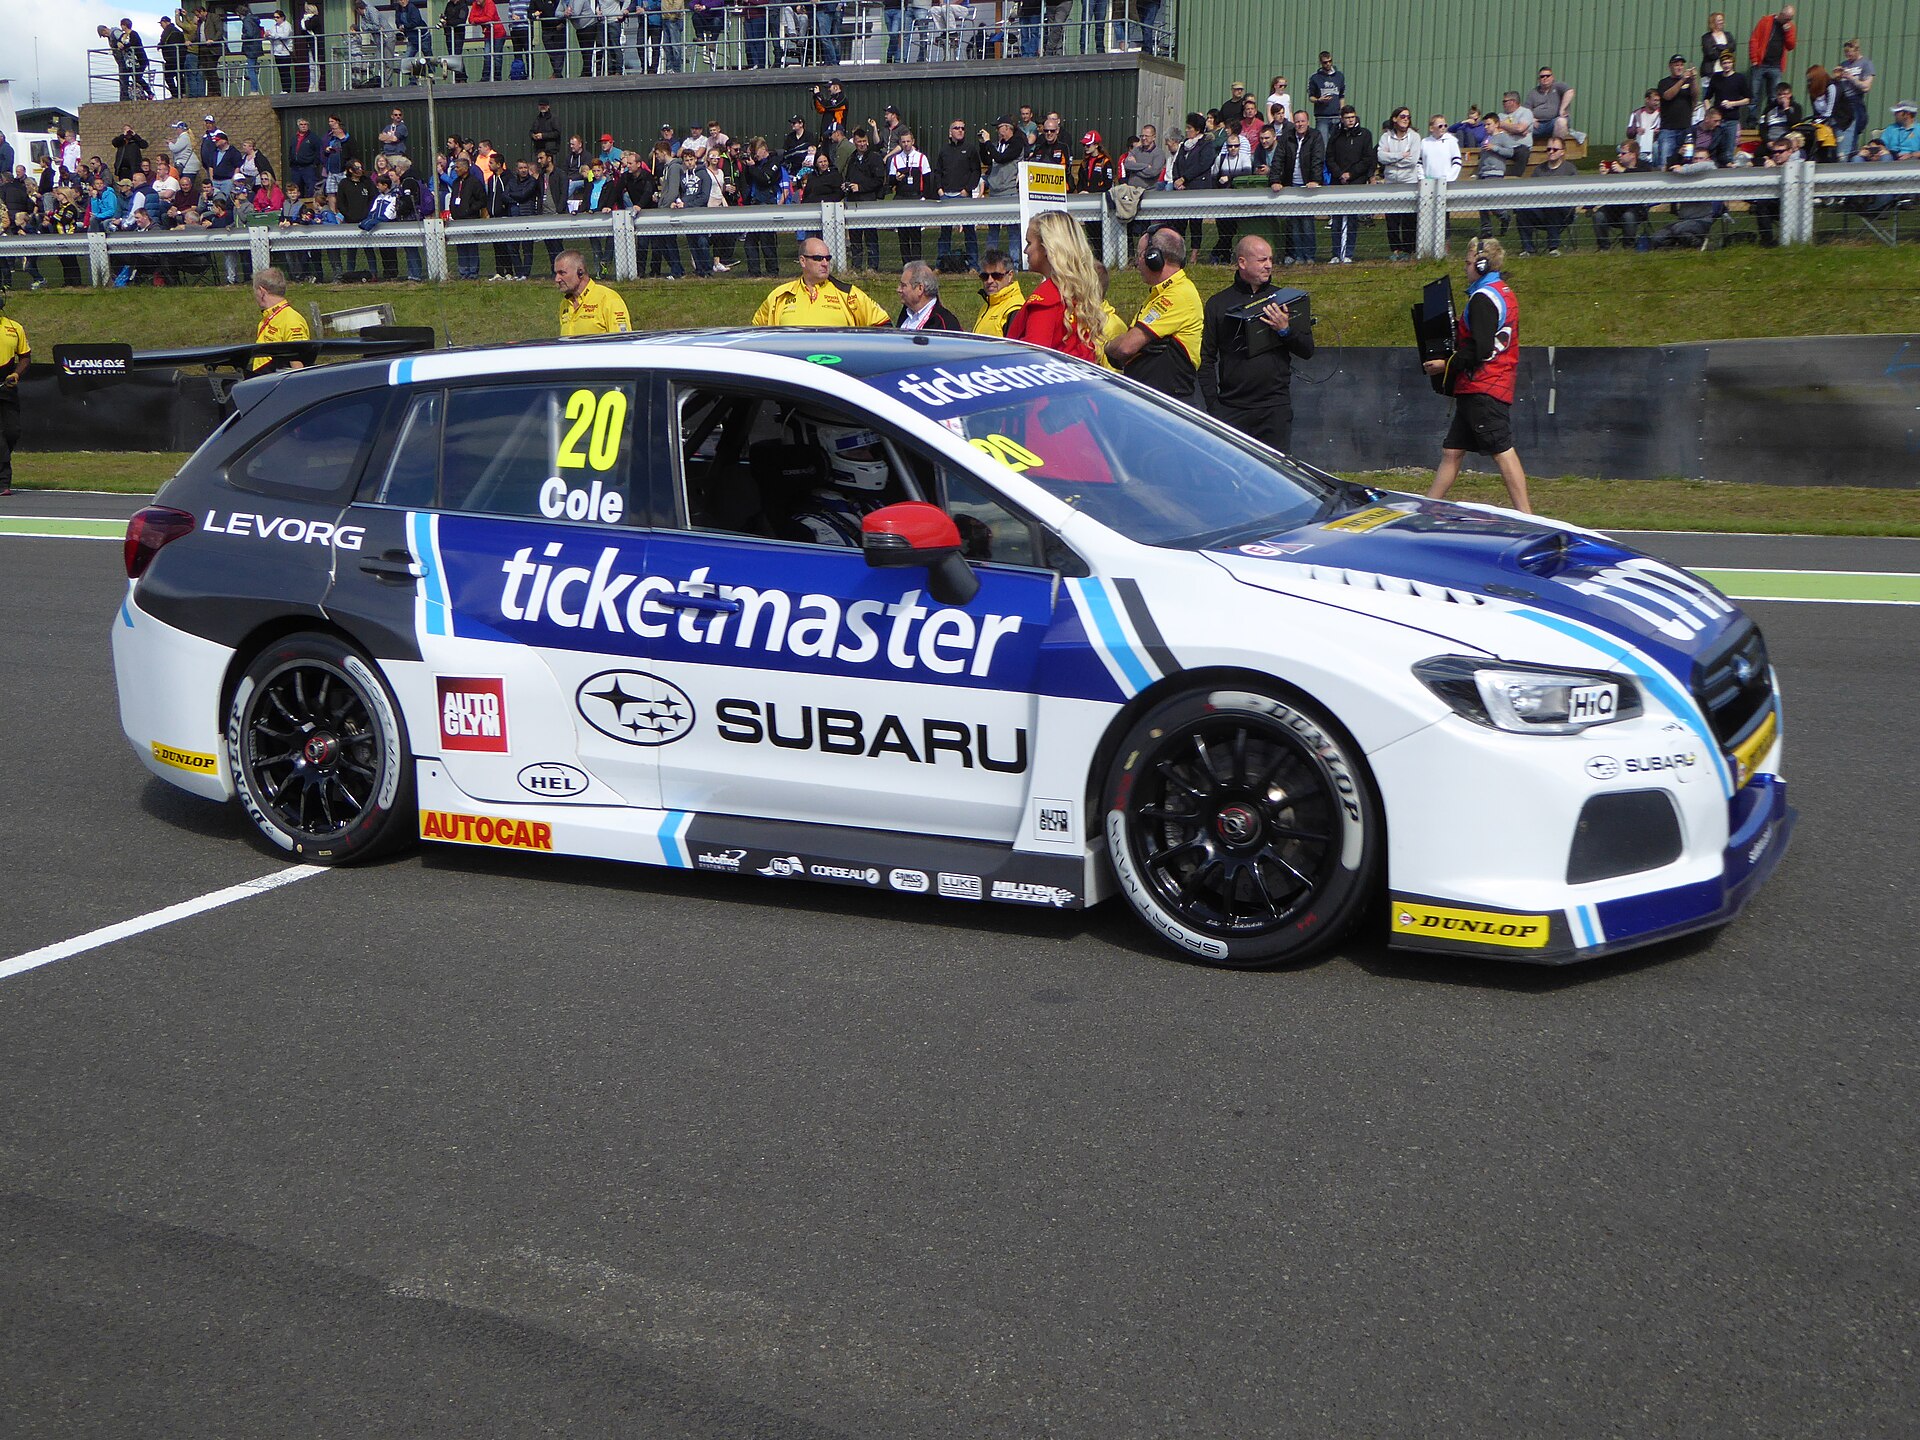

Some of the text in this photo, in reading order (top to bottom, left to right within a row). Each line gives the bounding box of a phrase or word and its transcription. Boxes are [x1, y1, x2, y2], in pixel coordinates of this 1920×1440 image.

[1036, 174, 1064, 185] DUNLOP
[68, 359, 125, 368] LEADING EDGE
[555, 389, 628, 471] 20
[968, 433, 1045, 473] 20
[539, 476, 624, 523] Cole
[203, 509, 366, 551] LEVORG
[501, 542, 1022, 678] ticketmaster
[444, 692, 499, 715] AUTO
[1575, 690, 1614, 717] HiQ
[444, 713, 501, 736] GLYM
[716, 698, 1028, 774] SUBARU
[161, 749, 215, 768] DUNLOP
[229, 702, 268, 824] DUNLOP
[1267, 703, 1360, 823] DUNLOP
[1625, 752, 1695, 772] SUBARU
[530, 776, 577, 790] HEL
[1040, 809, 1068, 821] AUTO
[1040, 819, 1069, 832] GLYM
[423, 812, 552, 850] AUTOCAR
[773, 860, 791, 874] itg
[810, 864, 866, 880] CORBEAU
[941, 877, 979, 888] LUKE
[1139, 902, 1221, 955] SPORT
[1419, 914, 1539, 938] DUNLOP
